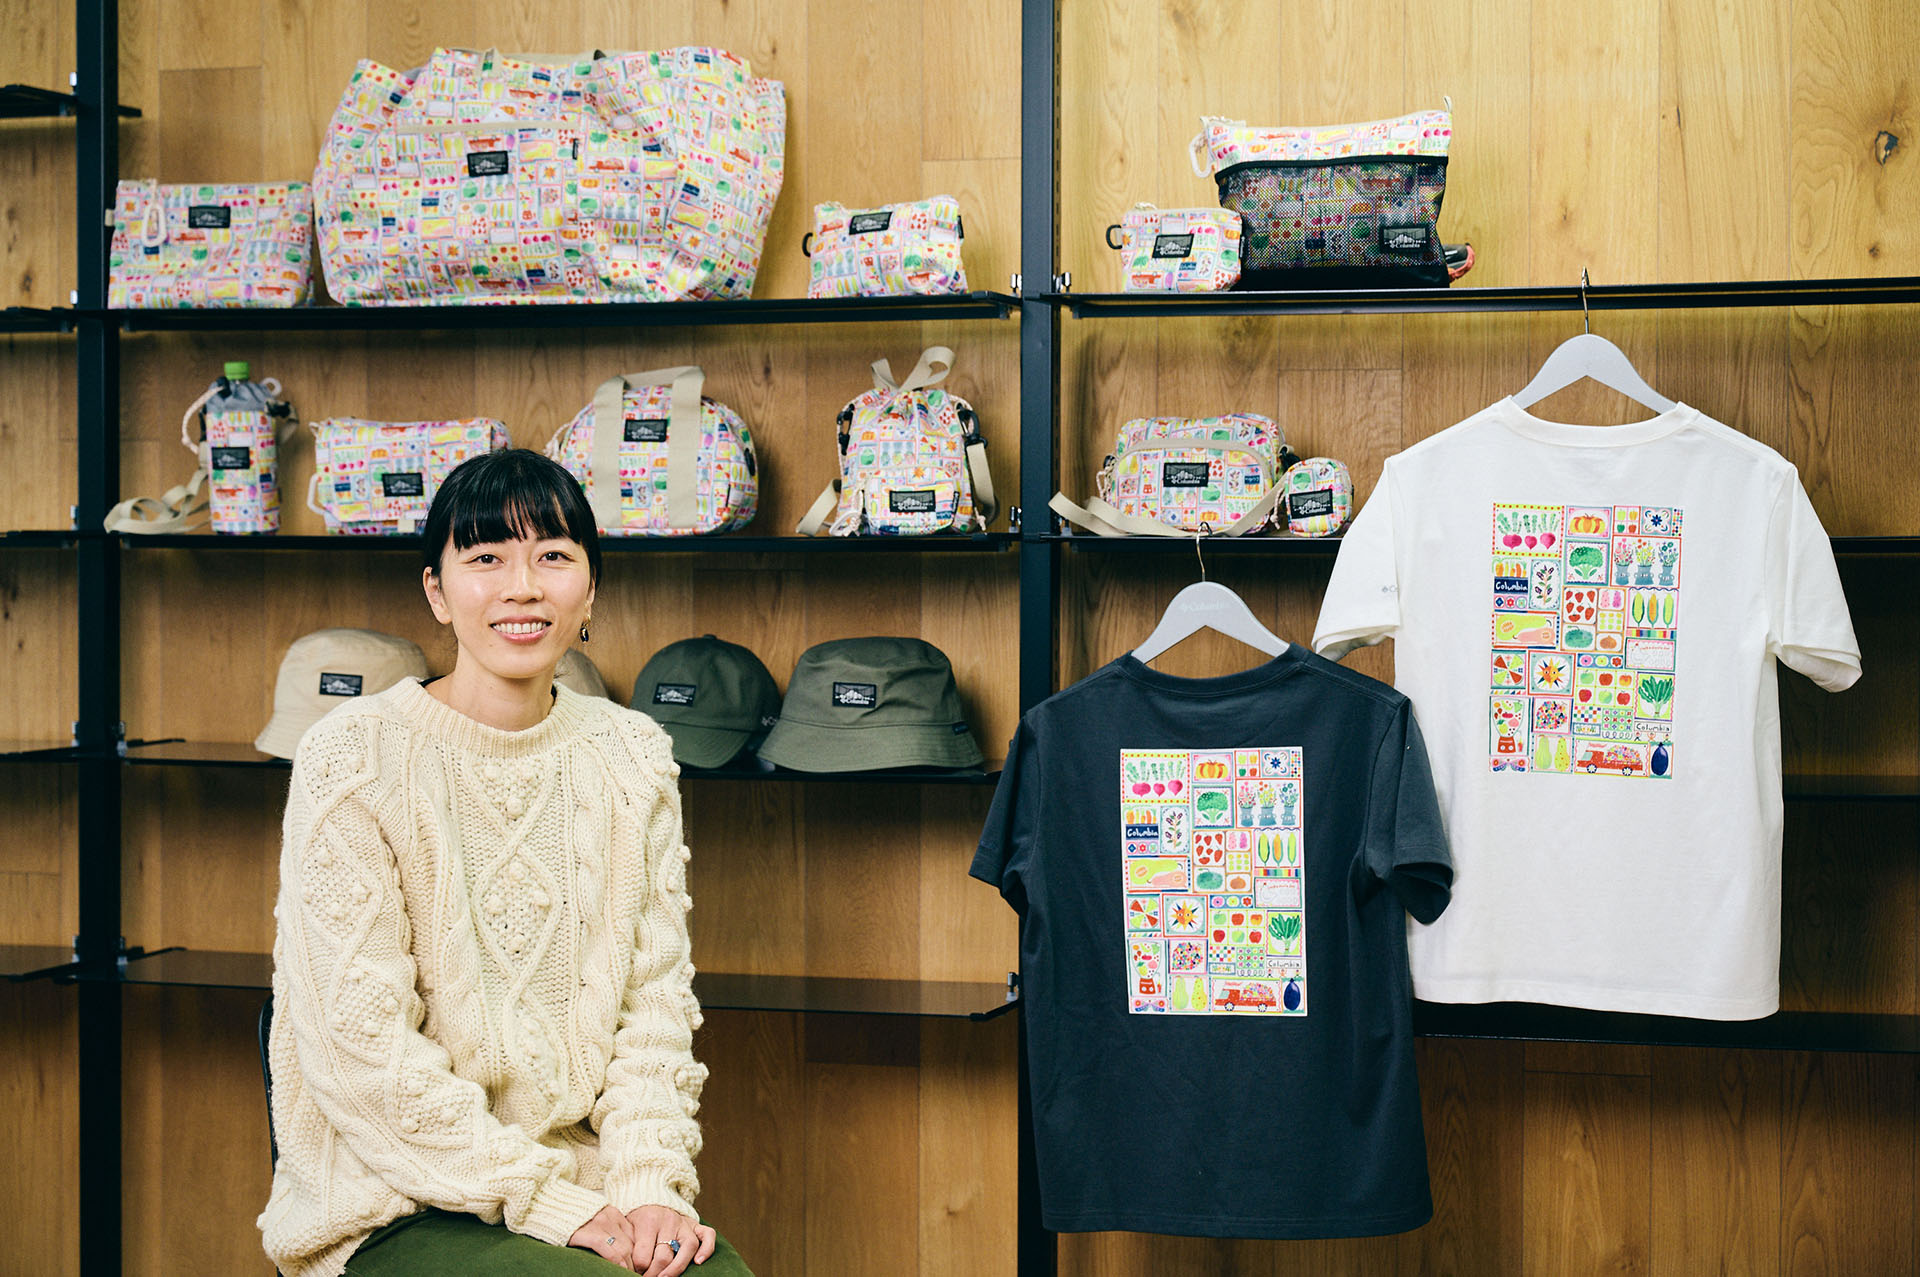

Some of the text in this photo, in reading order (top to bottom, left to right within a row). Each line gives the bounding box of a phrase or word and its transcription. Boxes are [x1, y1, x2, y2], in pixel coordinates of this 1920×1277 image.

[1495, 581, 1528, 590] Columbia
[1635, 722, 1669, 731] Columbia
[1127, 827, 1158, 837] Columbia
